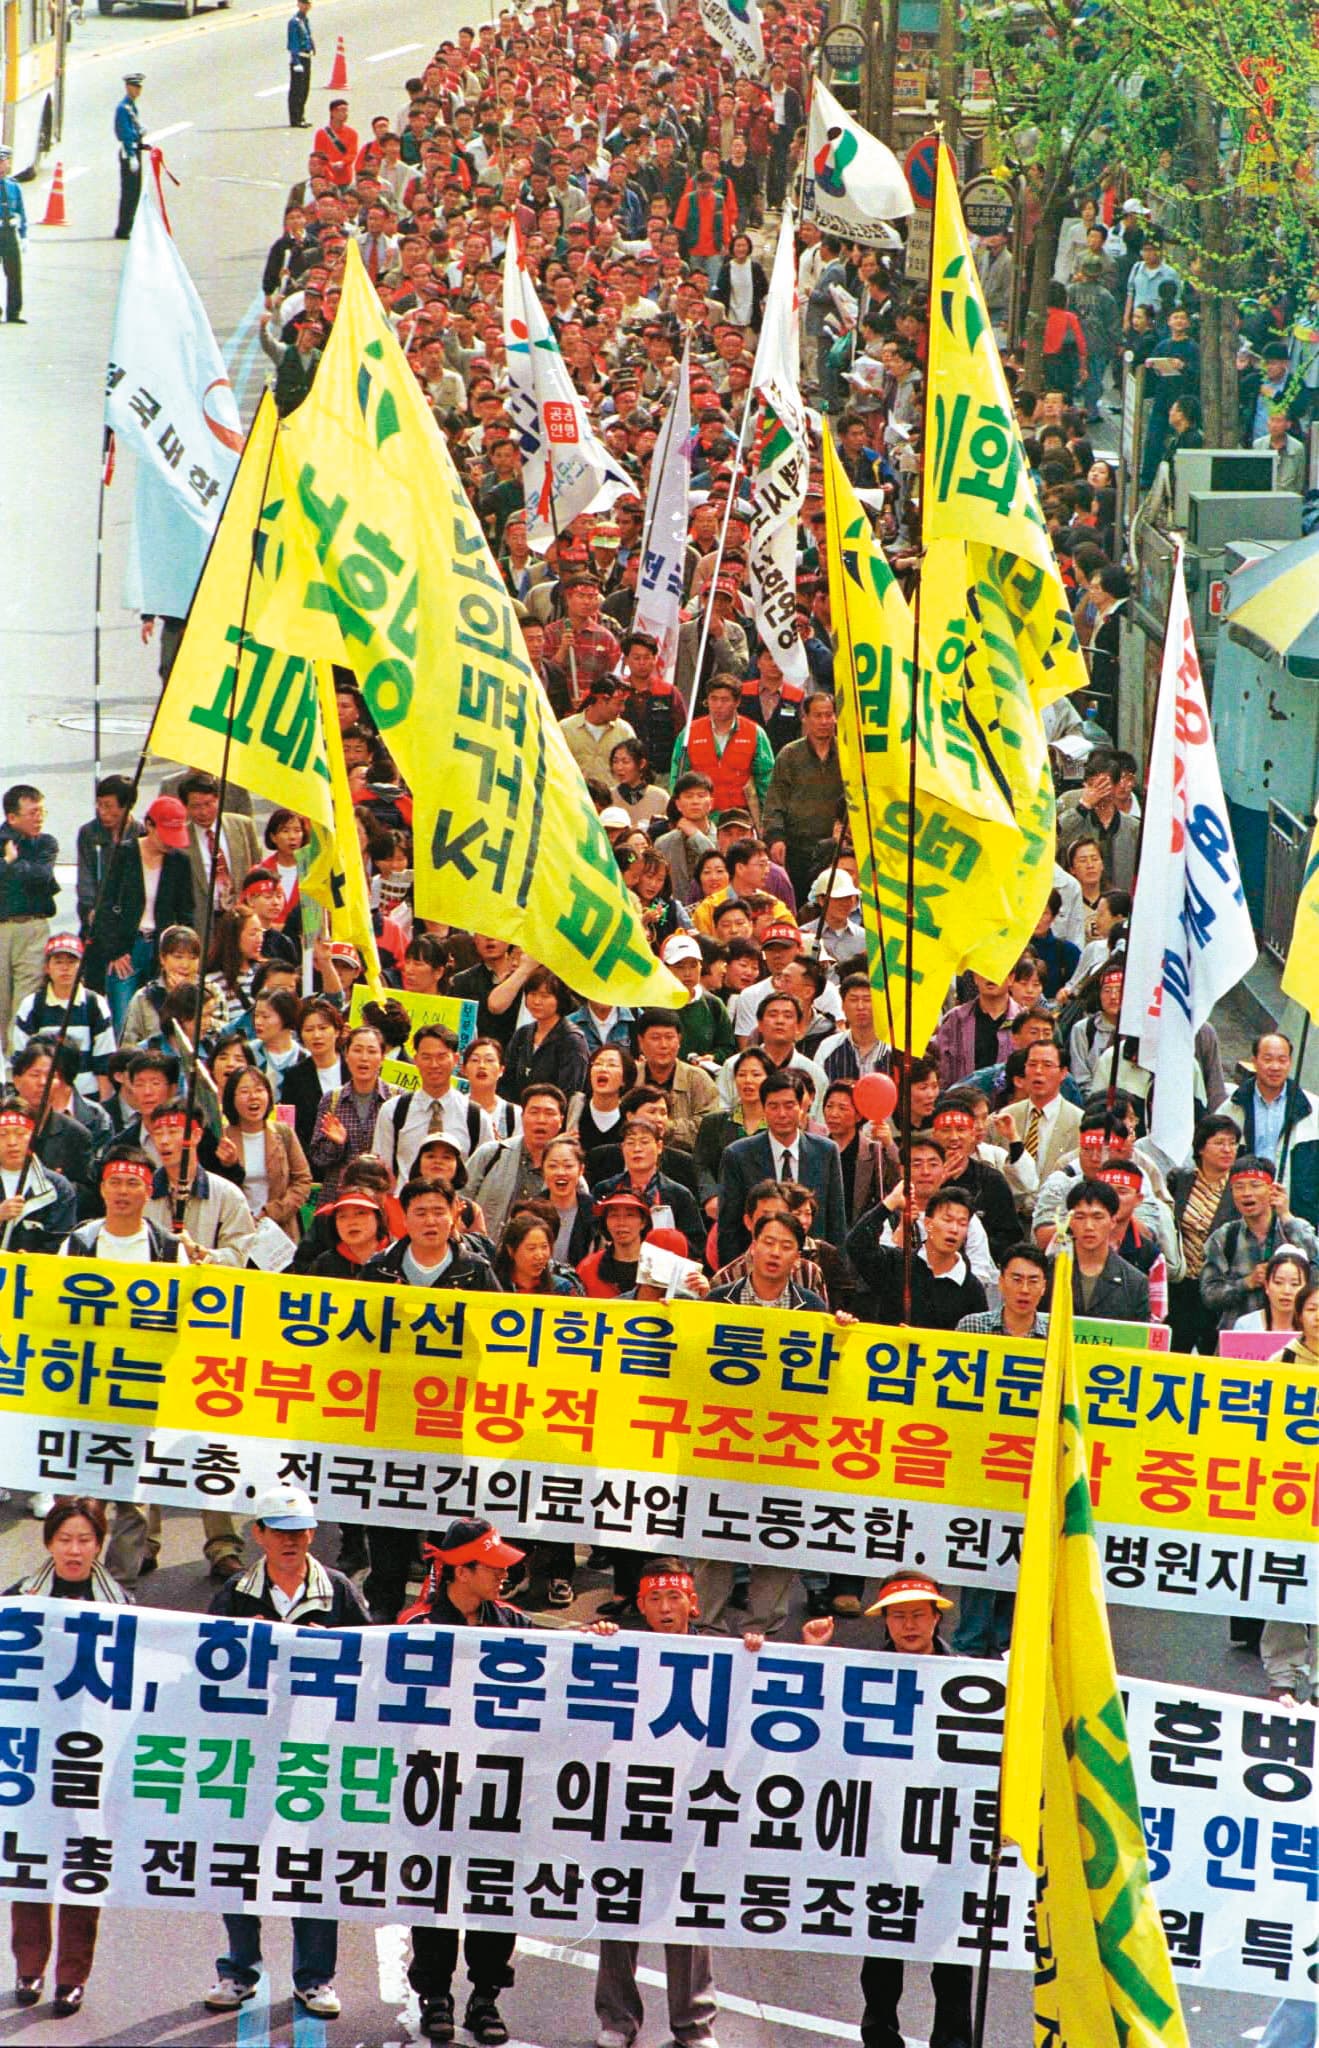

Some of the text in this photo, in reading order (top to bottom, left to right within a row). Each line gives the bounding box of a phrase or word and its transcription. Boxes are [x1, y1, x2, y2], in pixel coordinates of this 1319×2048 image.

[57, 1272, 245, 1339] 유일의
[279, 1289, 467, 1360] 방사선
[484, 1306, 678, 1379] 의학을
[707, 1321, 841, 1395] 통한
[191, 1353, 382, 1434] 정부의
[413, 1375, 596, 1453] 일방적
[629, 1397, 954, 1490] 구조조정을
[276, 1449, 685, 1540] 전국보건의료산업
[195, 1619, 1006, 1767] 한국보훈복지공단은
[132, 1733, 253, 1819] 즉각
[275, 1740, 527, 1833] 중단하고
[552, 1757, 872, 1860] 의료수요에
[1, 1831, 113, 1896] 노총
[142, 1839, 644, 1927] 전국보건의료산업
[675, 1870, 924, 1945] 노동조합
